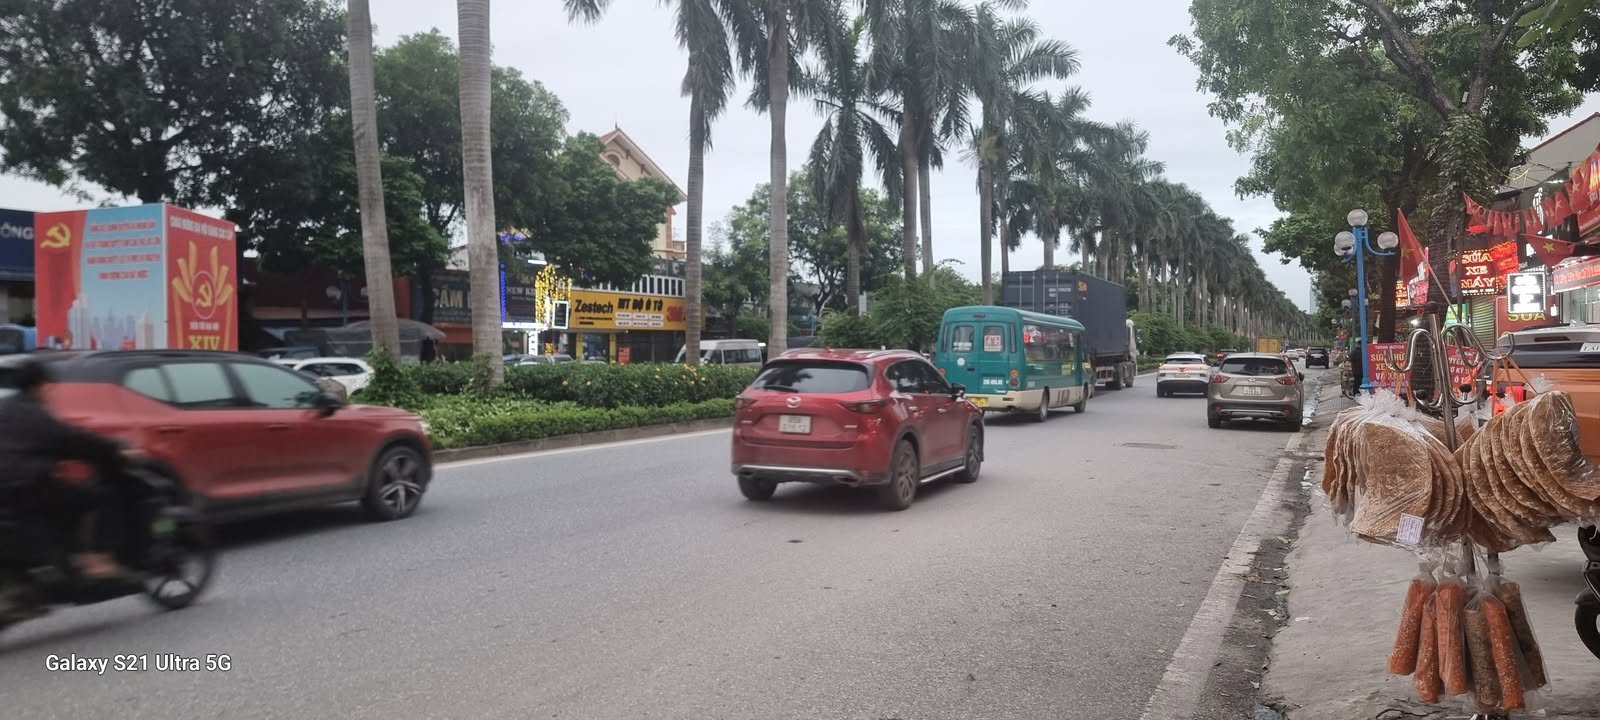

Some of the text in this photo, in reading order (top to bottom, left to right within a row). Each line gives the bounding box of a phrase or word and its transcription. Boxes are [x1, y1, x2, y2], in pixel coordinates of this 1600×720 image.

[1461, 276, 1495, 289] MÁY
[574, 299, 614, 314] Zestech
[188, 335, 220, 350] XIV
